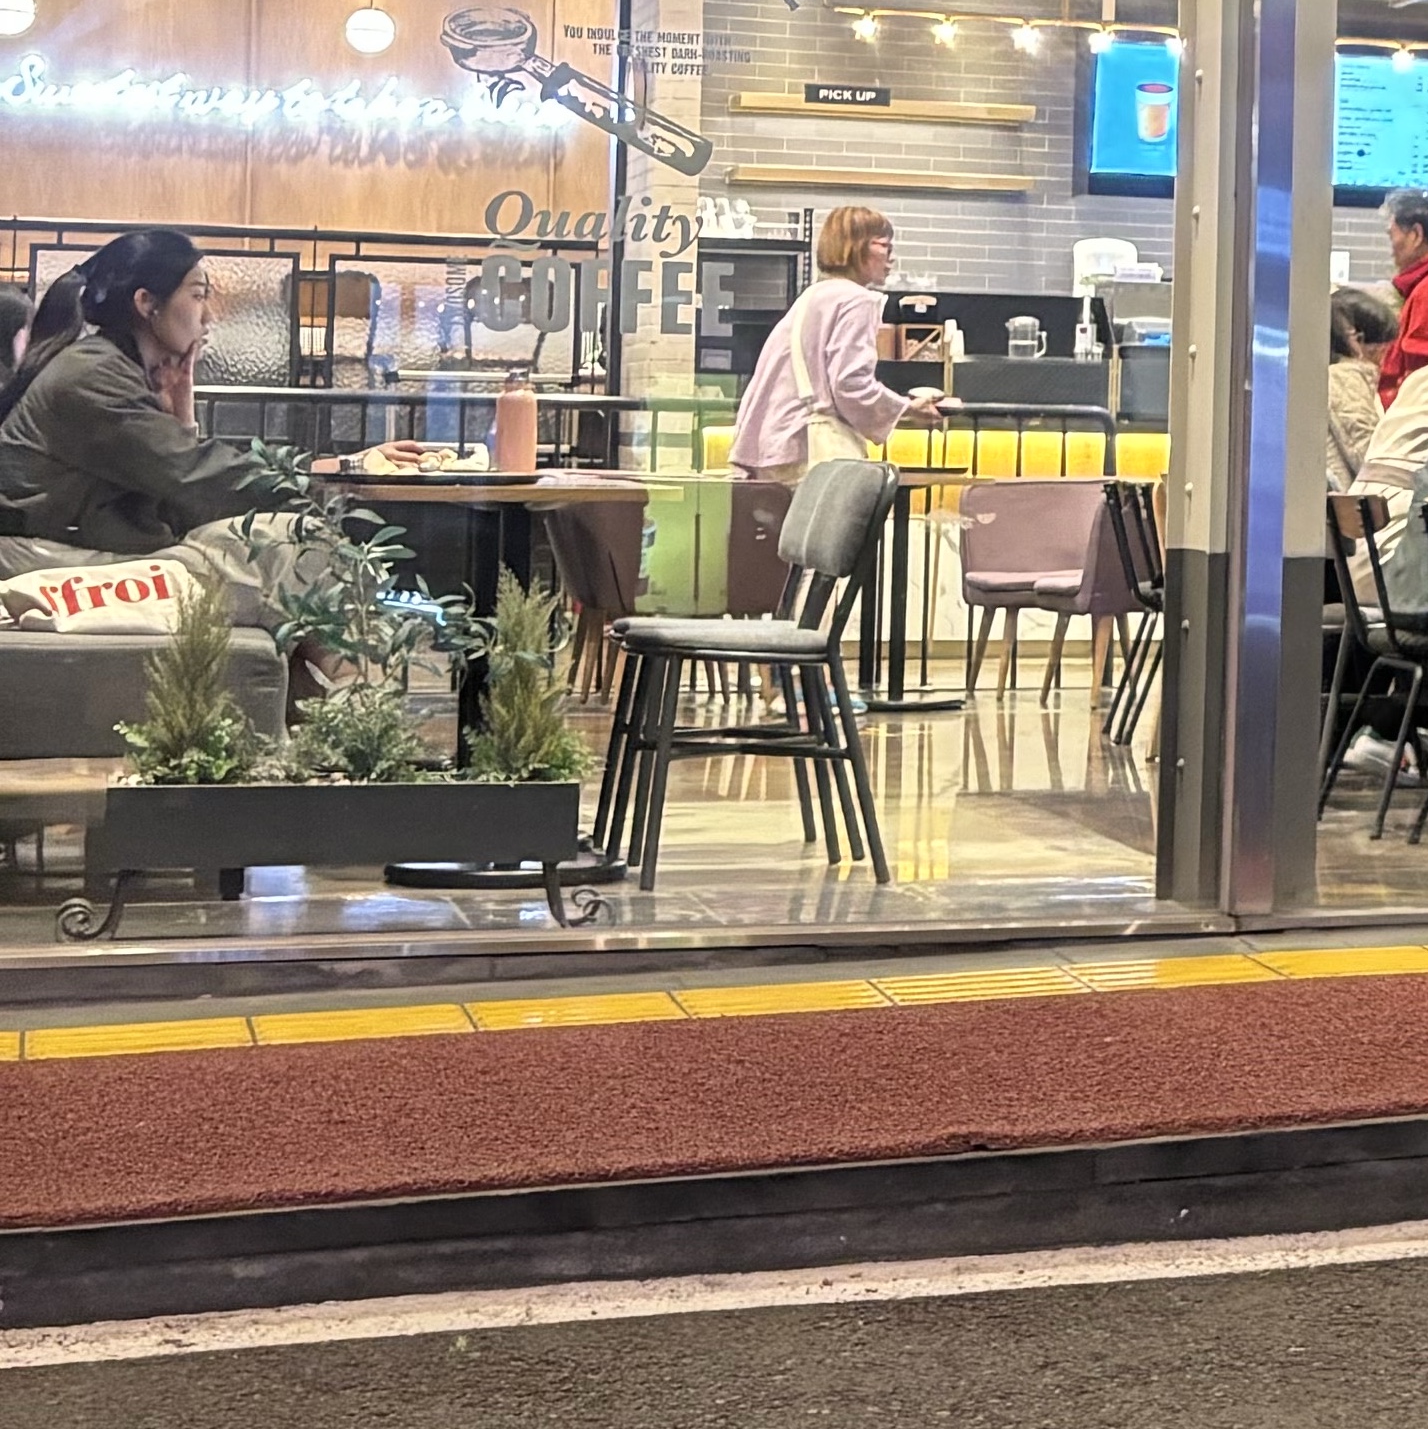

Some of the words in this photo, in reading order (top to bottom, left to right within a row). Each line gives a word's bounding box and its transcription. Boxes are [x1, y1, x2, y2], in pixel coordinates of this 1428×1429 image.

[563, 24, 583, 39] YOU
[635, 31, 654, 44] THE
[657, 32, 701, 45] MOMENT
[593, 43, 612, 56] THE
[817, 88, 853, 101] PICK
[855, 90, 877, 102] UP
[484, 189, 703, 259] Quality
[479, 254, 735, 337] COFFEE
